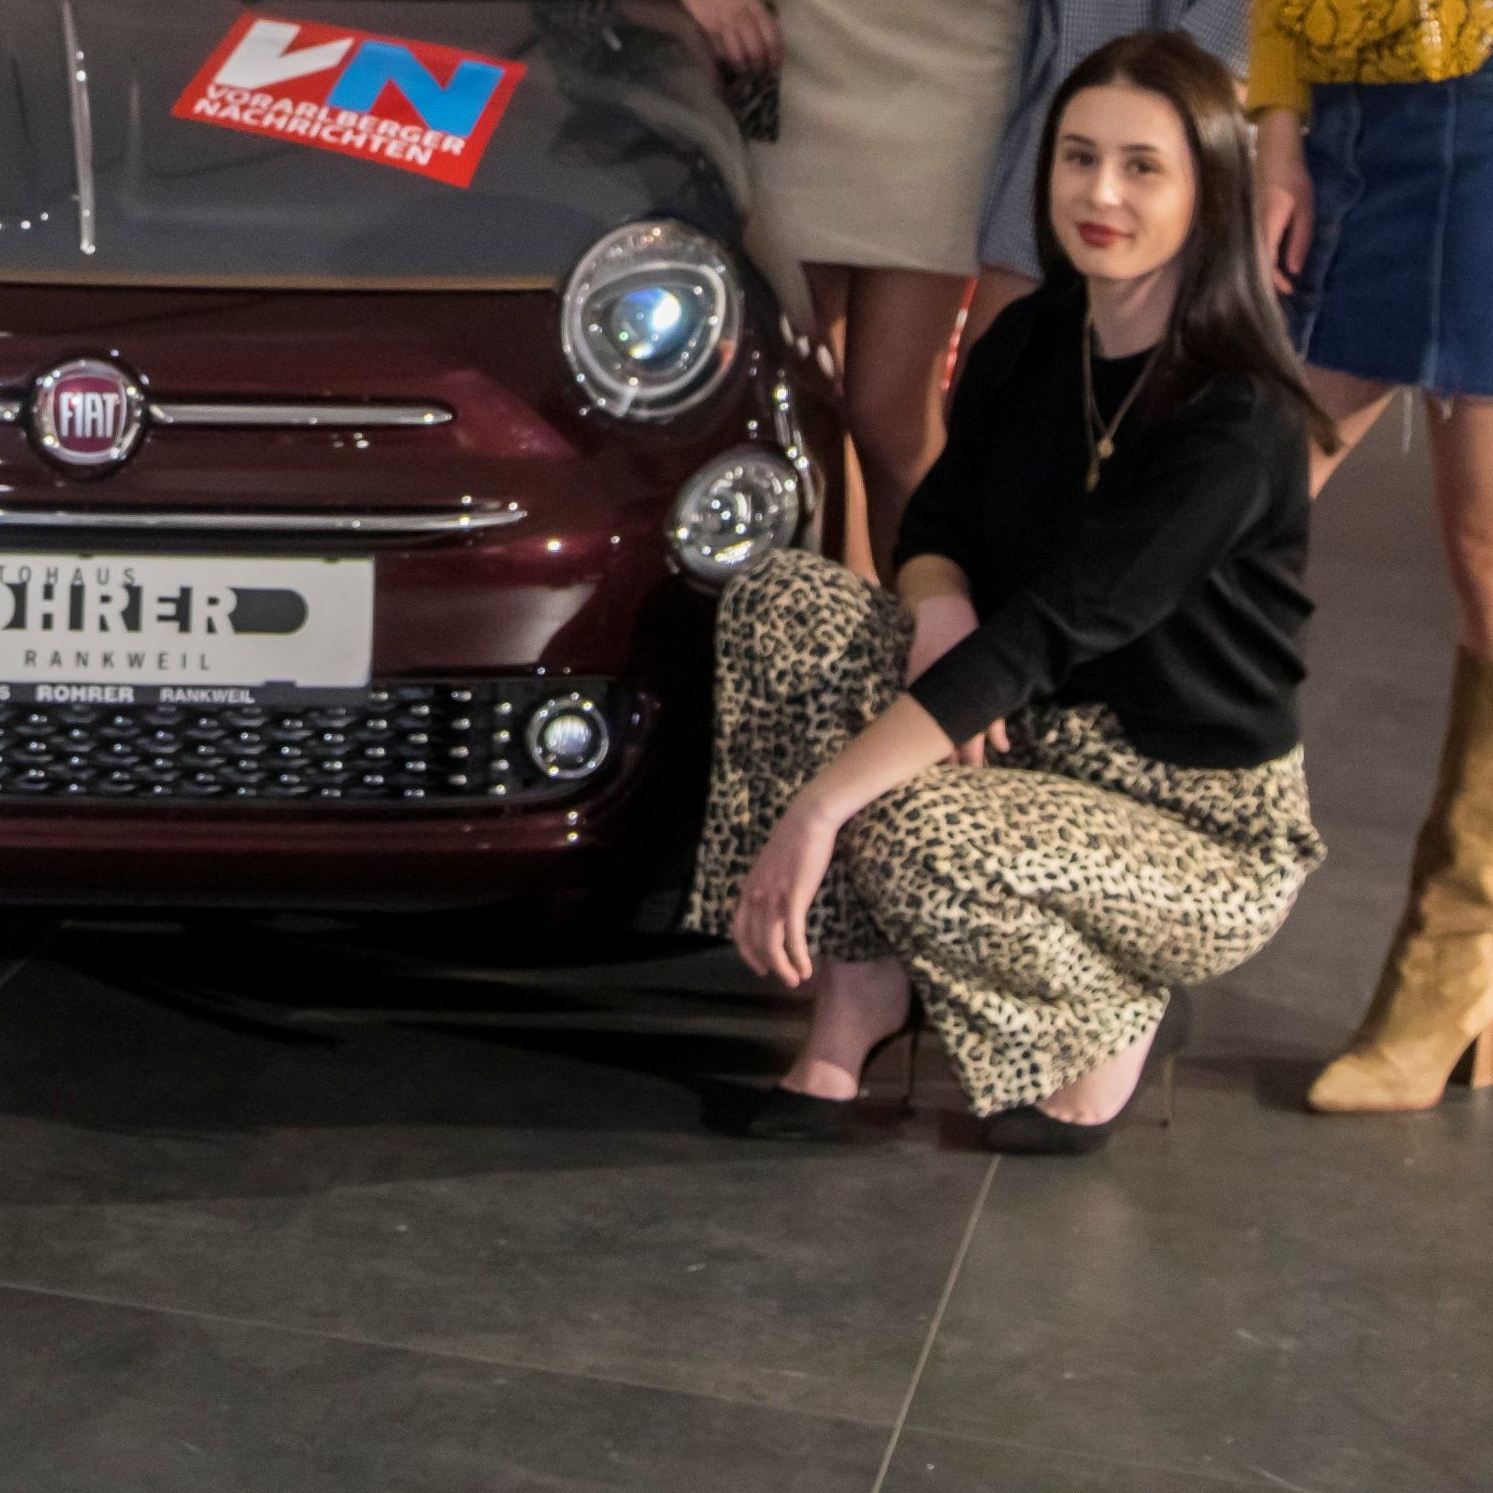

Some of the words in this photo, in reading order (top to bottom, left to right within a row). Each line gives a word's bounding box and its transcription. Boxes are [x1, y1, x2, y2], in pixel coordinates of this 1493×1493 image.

[213, 18, 506, 138] VN
[193, 99, 433, 166] NACHRICHTEN
[206, 84, 466, 156] VORARLBERGER
[58, 391, 120, 438] FIAT
[23, 649, 210, 671] RANKWEIL
[36, 684, 135, 703] ROHRER
[159, 687, 255, 704] RANKWEIL
